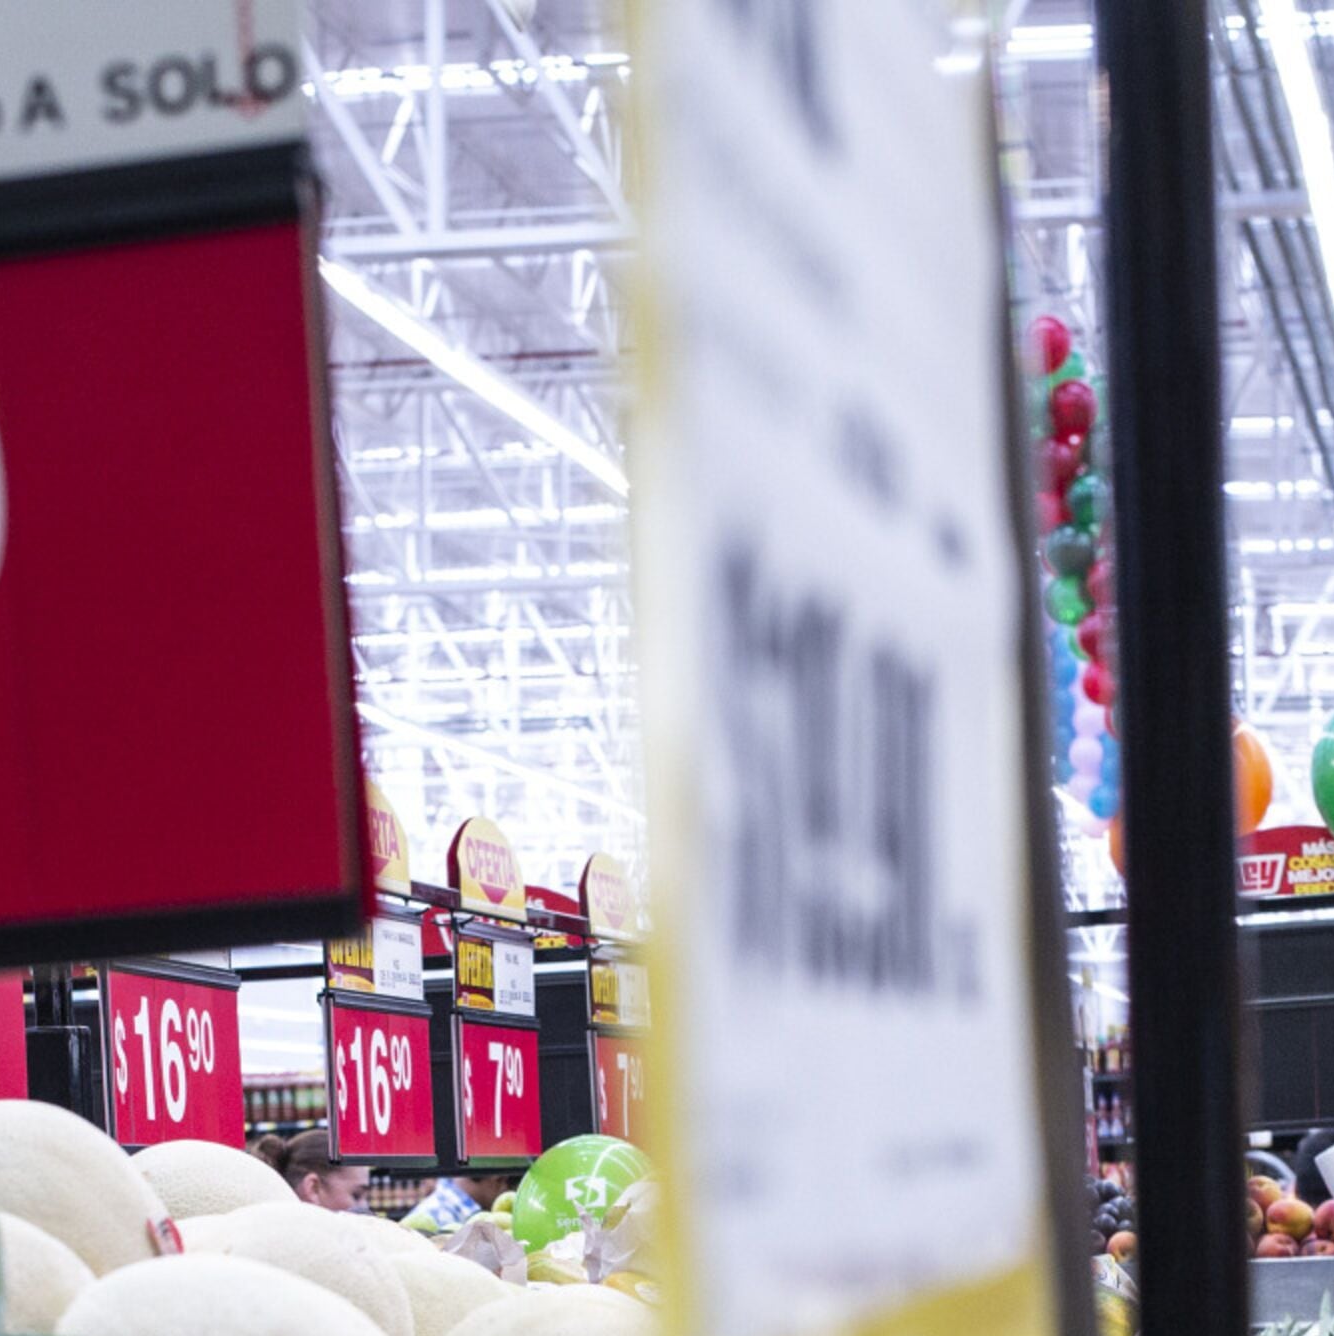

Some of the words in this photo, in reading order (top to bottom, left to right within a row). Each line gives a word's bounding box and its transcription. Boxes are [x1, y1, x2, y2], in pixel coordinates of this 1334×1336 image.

[17, 76, 67, 134] A
[101, 43, 298, 126] SOLO
[466, 835, 518, 889] OFERTA
